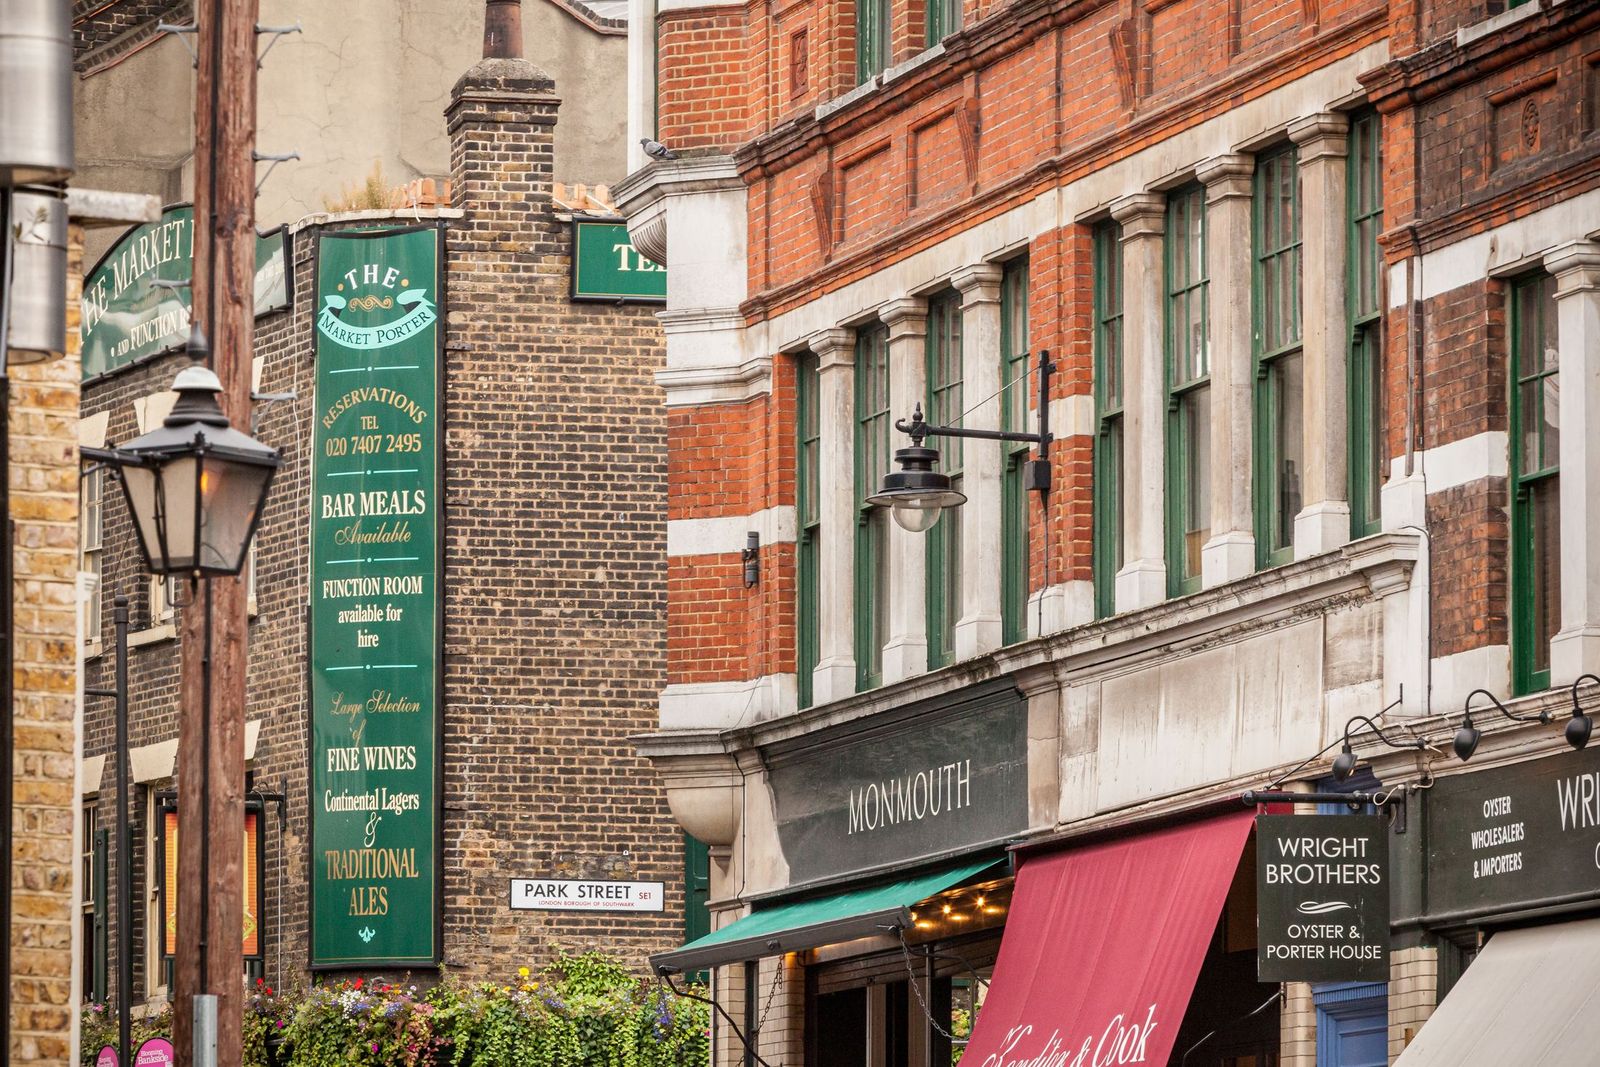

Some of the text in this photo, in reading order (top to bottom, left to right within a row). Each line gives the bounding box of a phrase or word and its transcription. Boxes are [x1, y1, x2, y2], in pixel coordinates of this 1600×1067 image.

[612, 243, 667, 272] TE
[80, 275, 109, 347] HE
[113, 218, 185, 301] MARKET
[344, 263, 400, 290] THE
[117, 339, 130, 357] AND
[129, 309, 178, 352] FUNCTION
[322, 387, 428, 429] RESERVATIONS
[361, 416, 379, 430] TEL
[326, 433, 422, 457] 020 7407 2495
[322, 489, 426, 519] BAR MEALS
[334, 519, 412, 545] Available
[323, 575, 423, 599] FUNCTION ROOM
[338, 603, 403, 624] available for
[357, 629, 379, 648] hire
[330, 689, 421, 722] Large Selection
[351, 717, 367, 748] of
[327, 745, 417, 772] FINE WINES
[325, 787, 420, 816] Continental Lagers
[847, 759, 971, 835] MONMOUTH
[1483, 796, 1512, 818] OYSTER
[1557, 771, 1600, 832] WRI
[364, 811, 382, 848] &
[1471, 822, 1525, 850] WHOLESALERS
[1277, 837, 1369, 858] WRIGHT
[325, 848, 420, 880] TRADITIONAL
[1266, 863, 1381, 884] BROTHERS
[1473, 852, 1523, 879] & IMPORTERS
[349, 886, 389, 917] ALES
[525, 883, 652, 900] PARK STREET SE1
[1287, 924, 1361, 939] OYSTER &
[1266, 945, 1381, 959] PORTER HOUSE
[1069, 1035, 1093, 1067] &
[1091, 1003, 1158, 1067] Cook
[138, 1054, 169, 1065] Bankside
